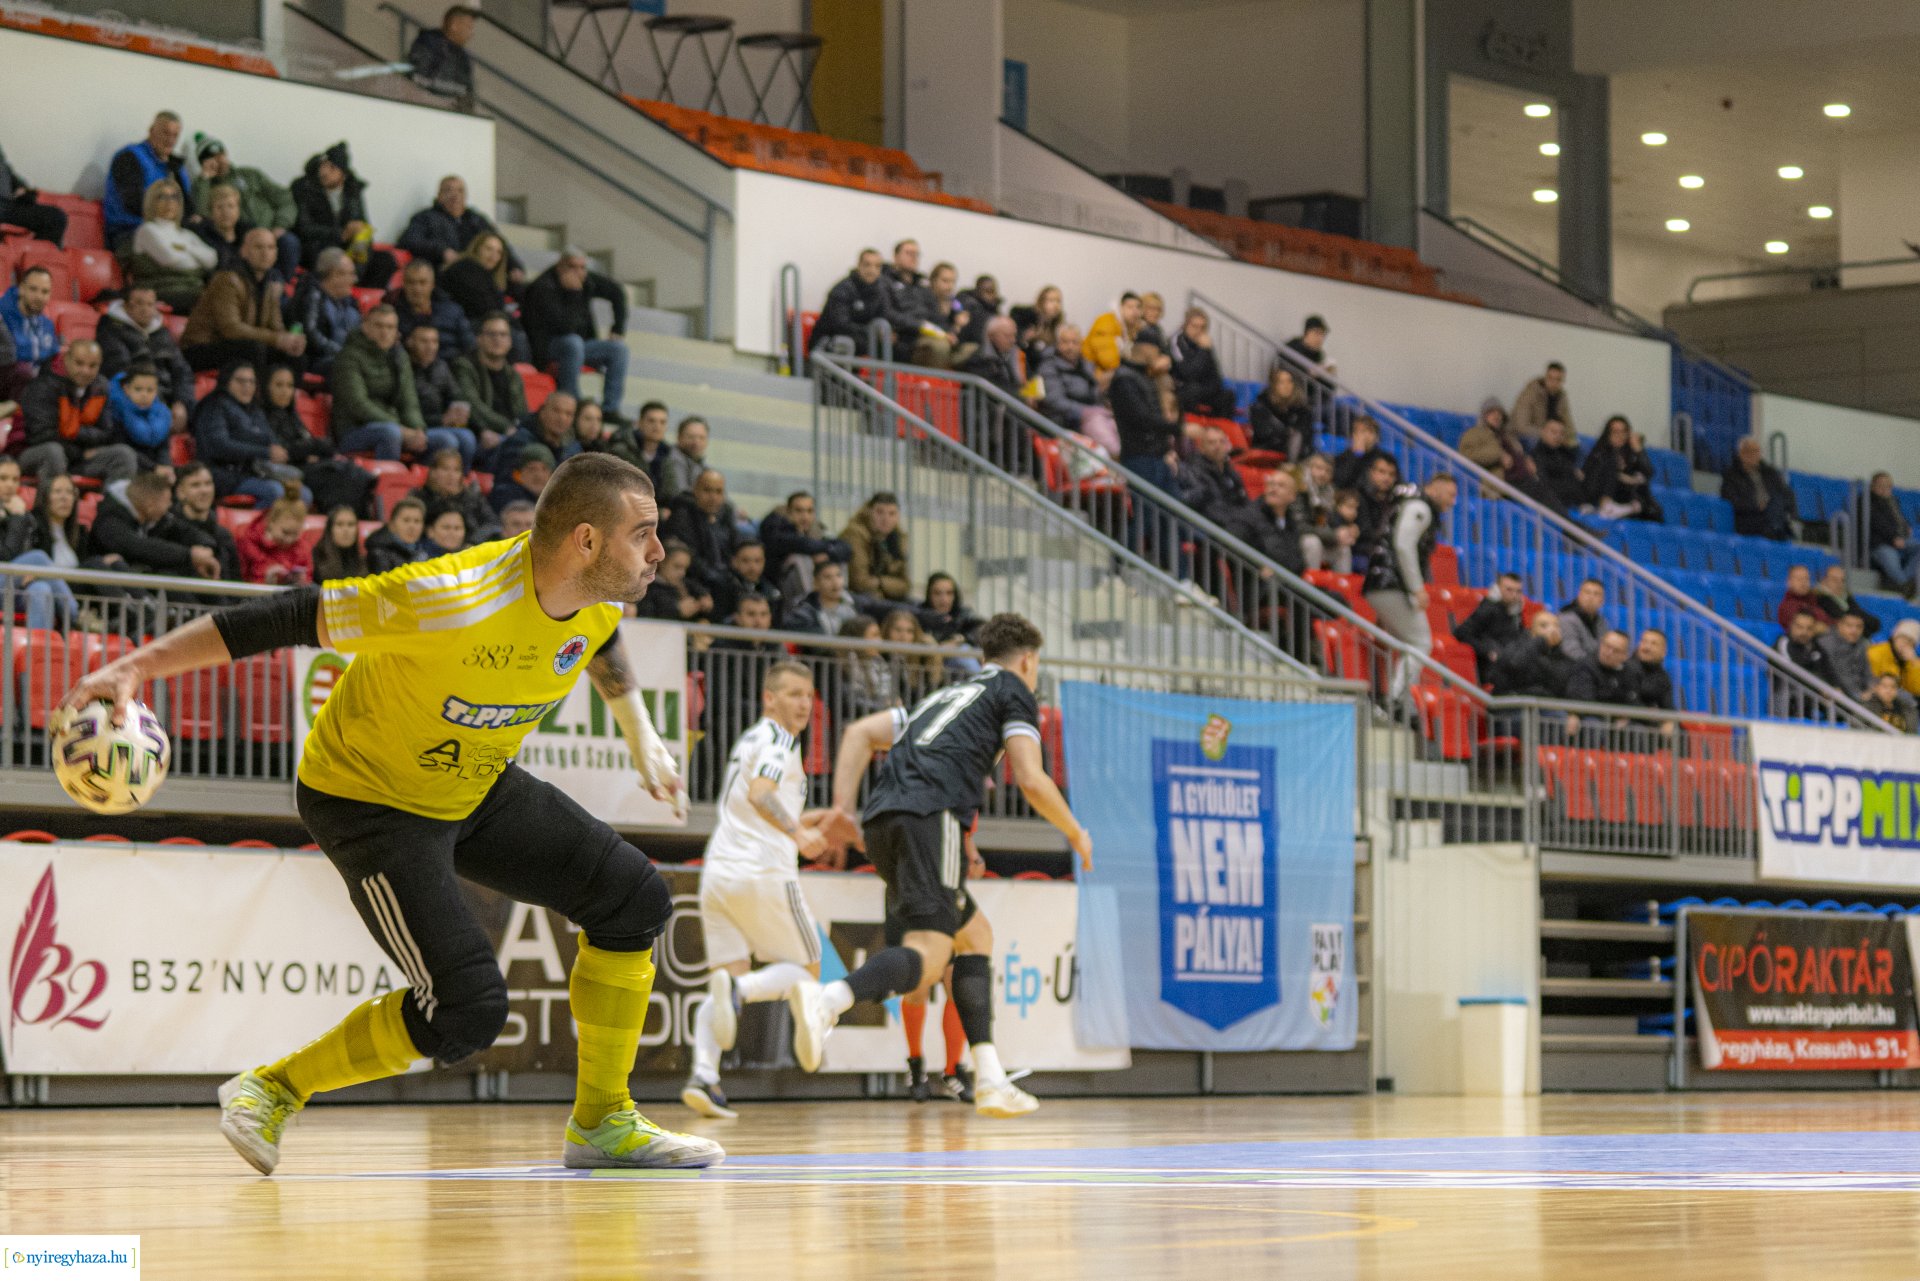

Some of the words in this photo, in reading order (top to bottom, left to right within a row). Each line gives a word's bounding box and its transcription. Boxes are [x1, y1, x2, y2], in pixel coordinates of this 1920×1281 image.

[462, 644, 514, 670] 383
[1170, 781, 1183, 815] A
[1170, 816, 1265, 906] NEM
[1174, 905, 1264, 974] PÁLYA!
